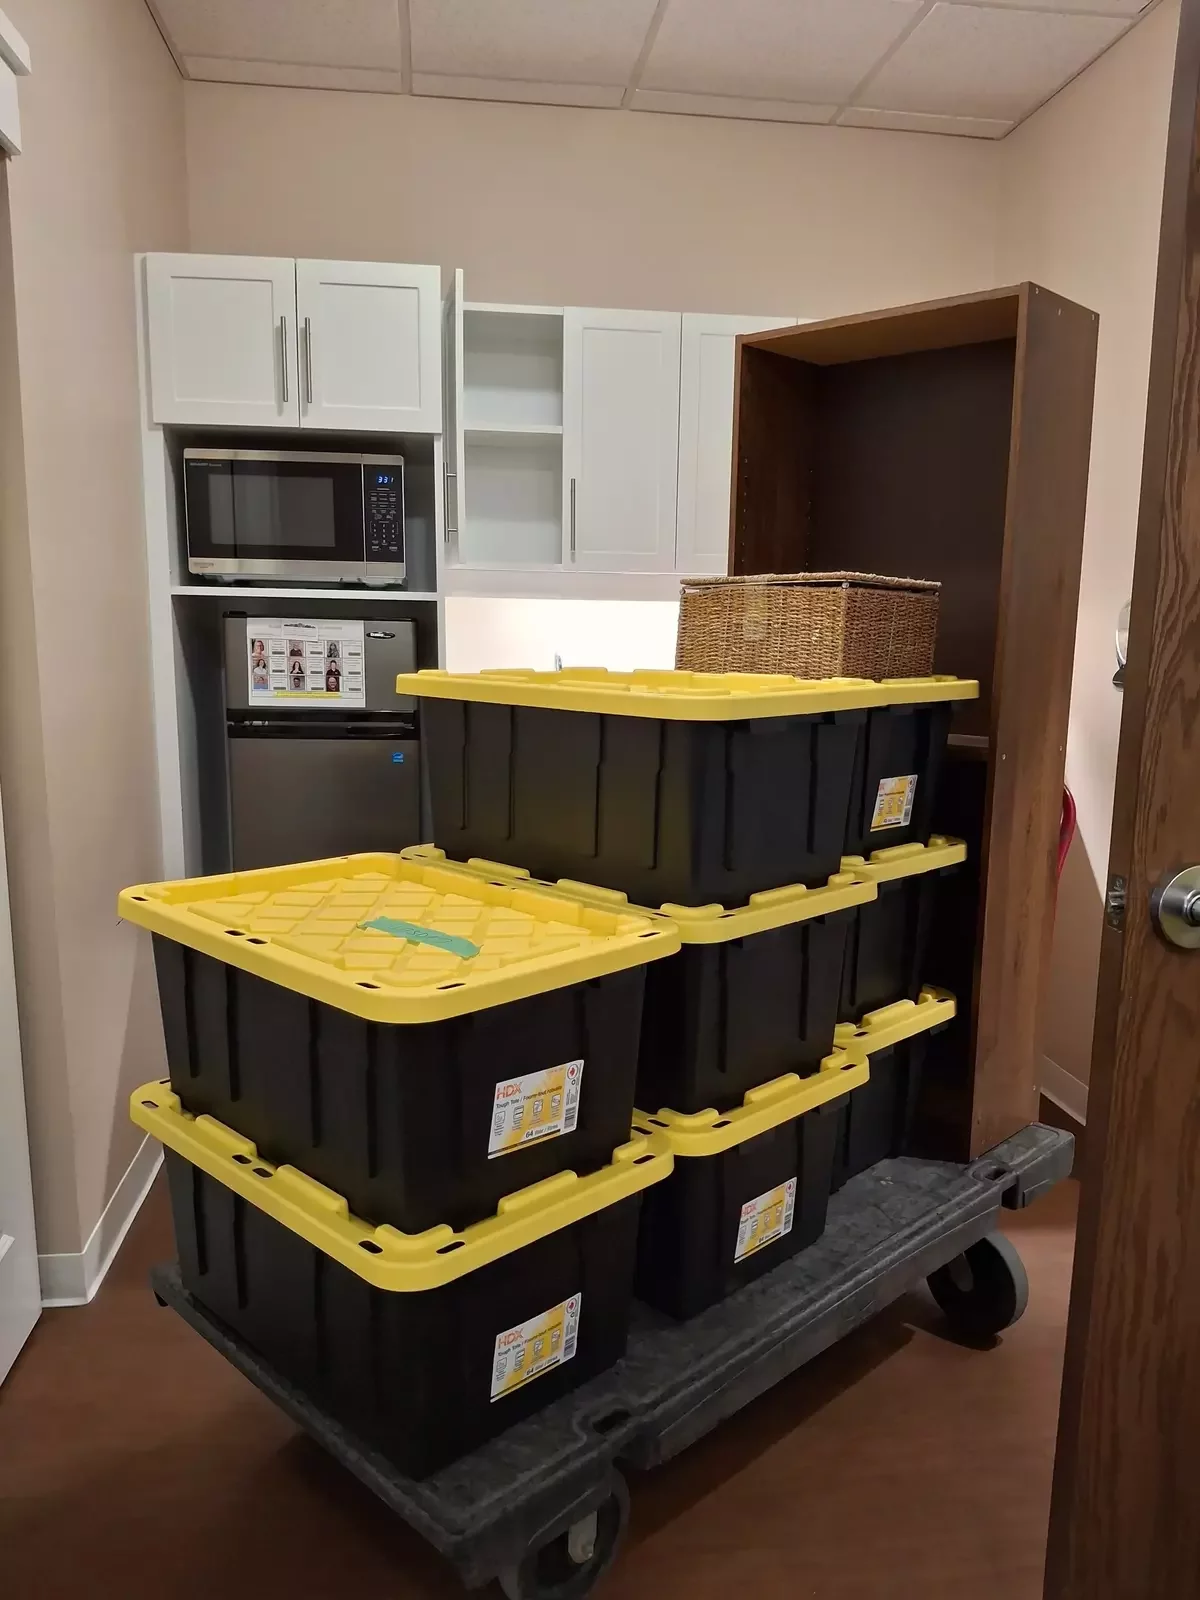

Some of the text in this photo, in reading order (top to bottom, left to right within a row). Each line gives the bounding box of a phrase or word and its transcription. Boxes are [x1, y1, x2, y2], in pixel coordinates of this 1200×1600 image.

[496, 1083, 522, 1100] HDX
[525, 1130, 534, 1138] 64
[498, 1328, 524, 1349] HDX
